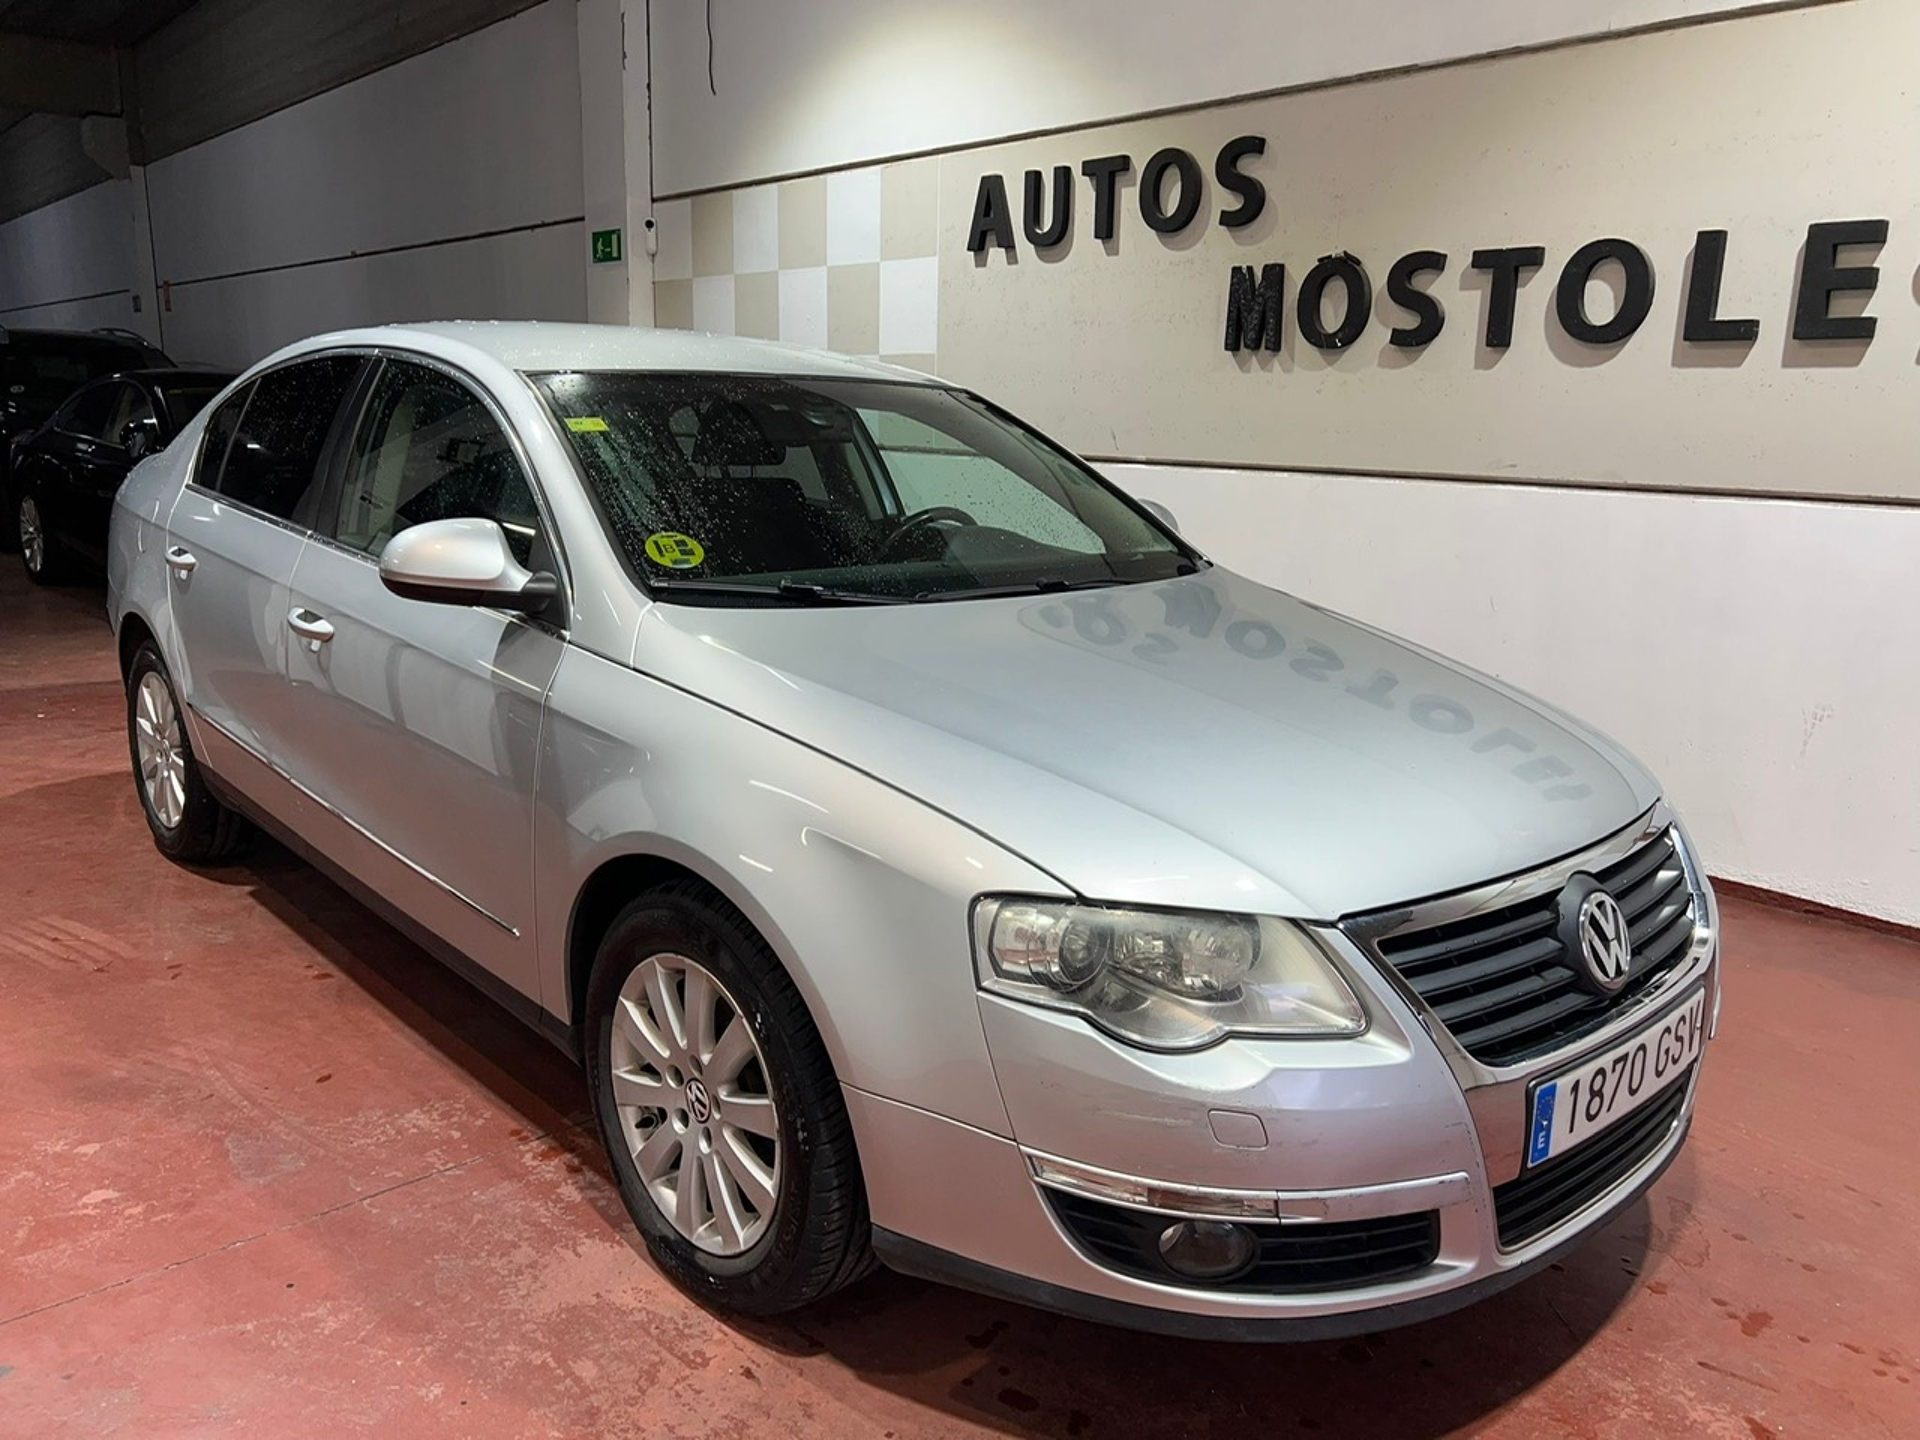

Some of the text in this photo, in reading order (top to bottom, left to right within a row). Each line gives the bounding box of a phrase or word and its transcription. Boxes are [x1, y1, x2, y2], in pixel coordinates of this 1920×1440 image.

[967, 135, 1267, 253] AUTOS
[1224, 219, 1890, 352] MOSTOLE
[1569, 1042, 1647, 1134] 1870
